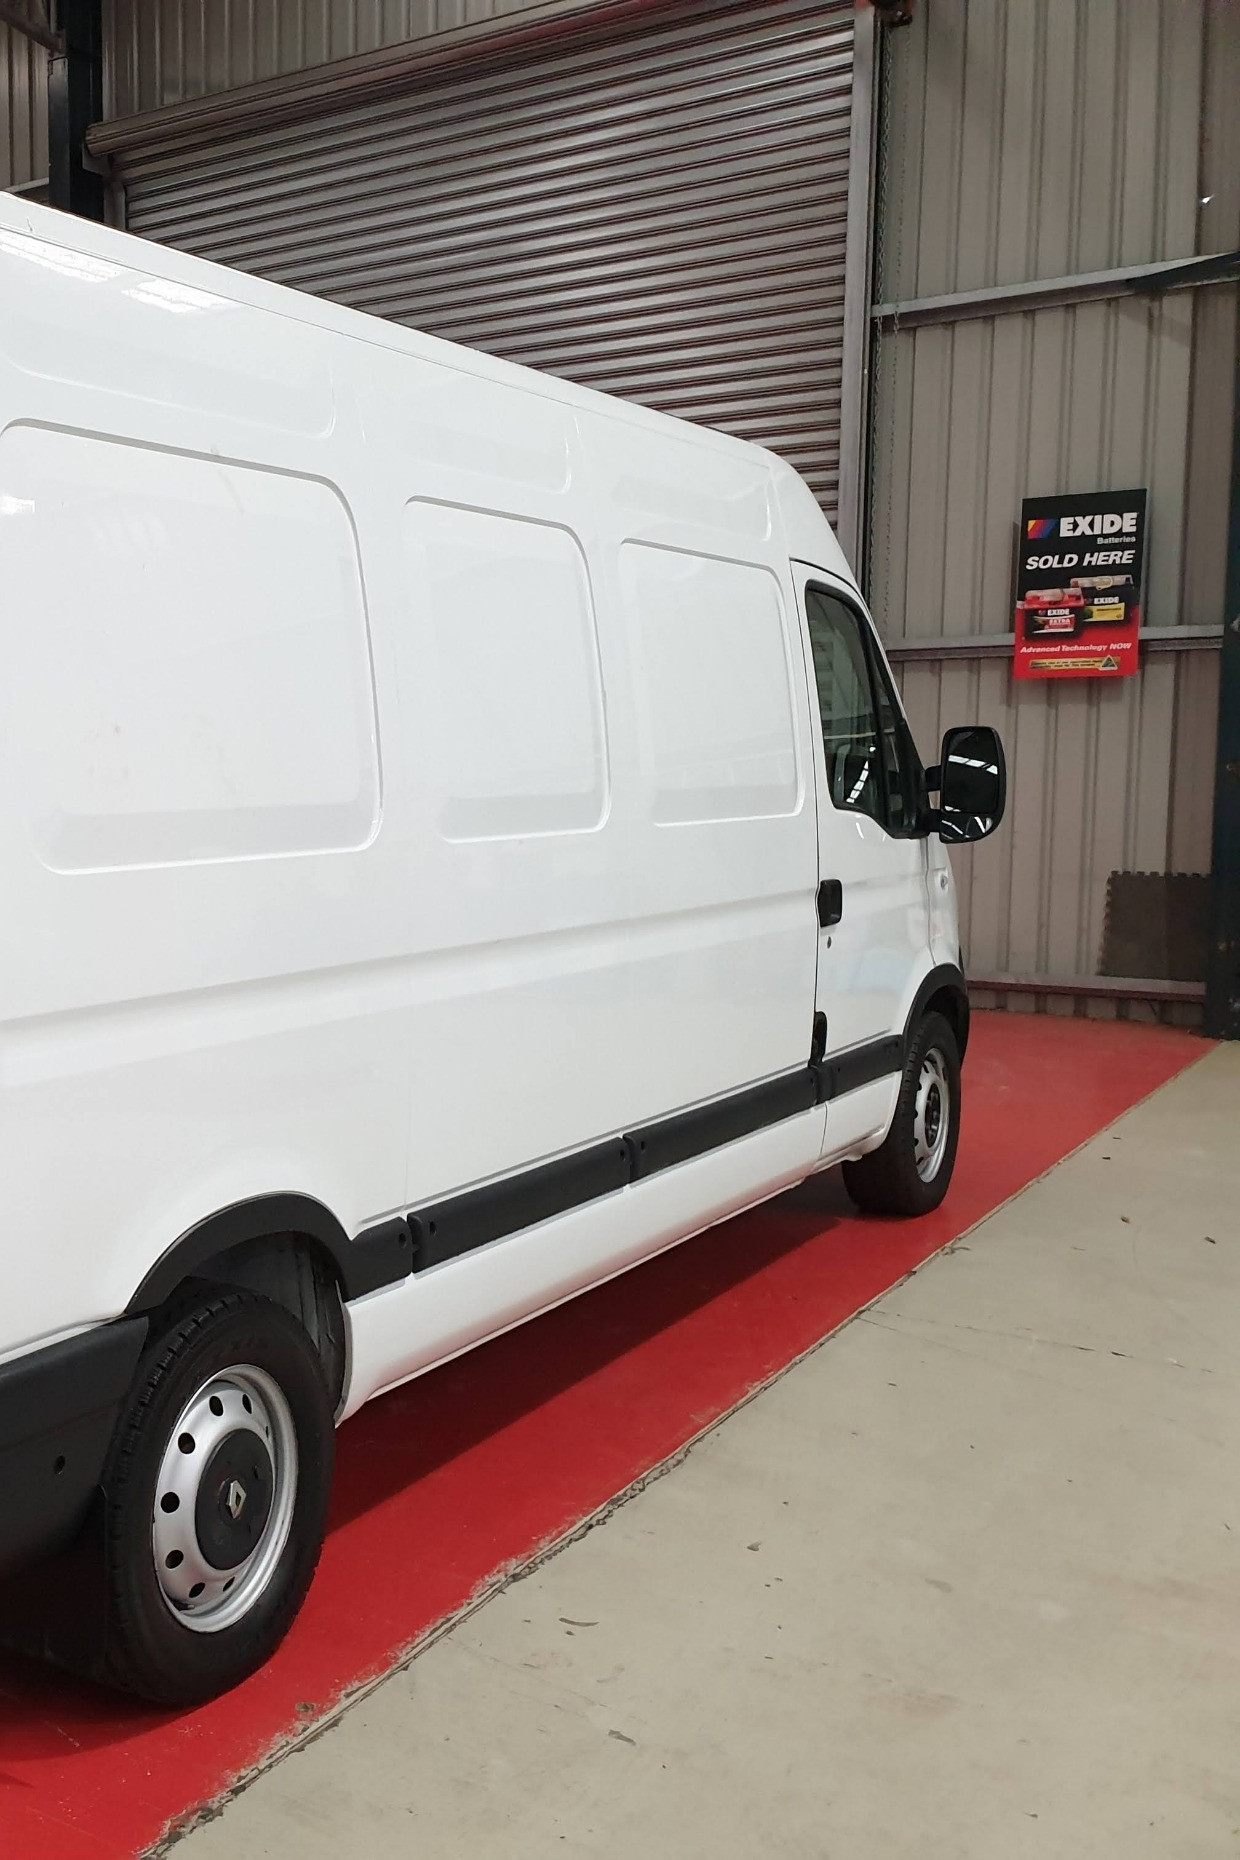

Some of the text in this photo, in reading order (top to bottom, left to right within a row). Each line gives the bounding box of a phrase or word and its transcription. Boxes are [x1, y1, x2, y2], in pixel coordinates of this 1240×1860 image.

[1059, 512, 1138, 538] EXIDE
[1096, 535, 1136, 545] Batteries
[1025, 549, 1136, 571] SOLD HERE
[1093, 596, 1120, 605] EXIDE
[1047, 608, 1070, 616] EXIDE
[1020, 642, 1132, 654] Advanced Technology NOW
